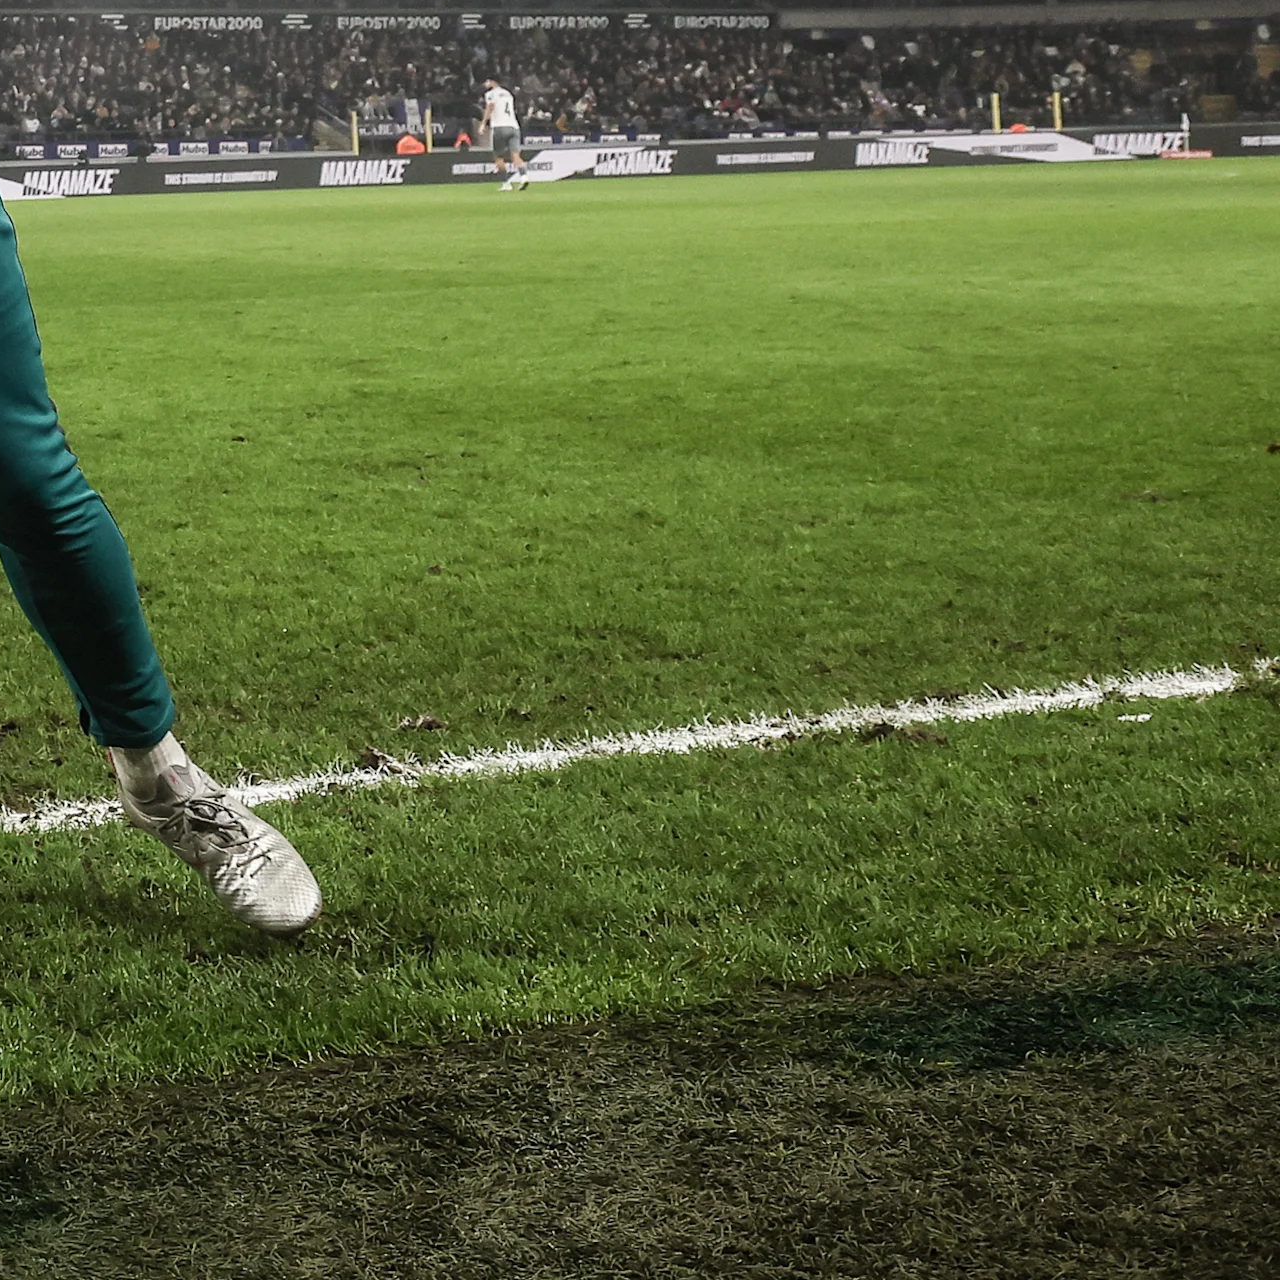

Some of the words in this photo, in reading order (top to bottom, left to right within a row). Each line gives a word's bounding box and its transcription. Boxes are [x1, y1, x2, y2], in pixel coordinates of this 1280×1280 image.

[593, 150, 676, 176] MAXAMAZE
[855, 142, 928, 166] MAXAMAZE
[23, 169, 118, 196] MAXAMAZE
[320, 159, 410, 187] MAXAMAZE
